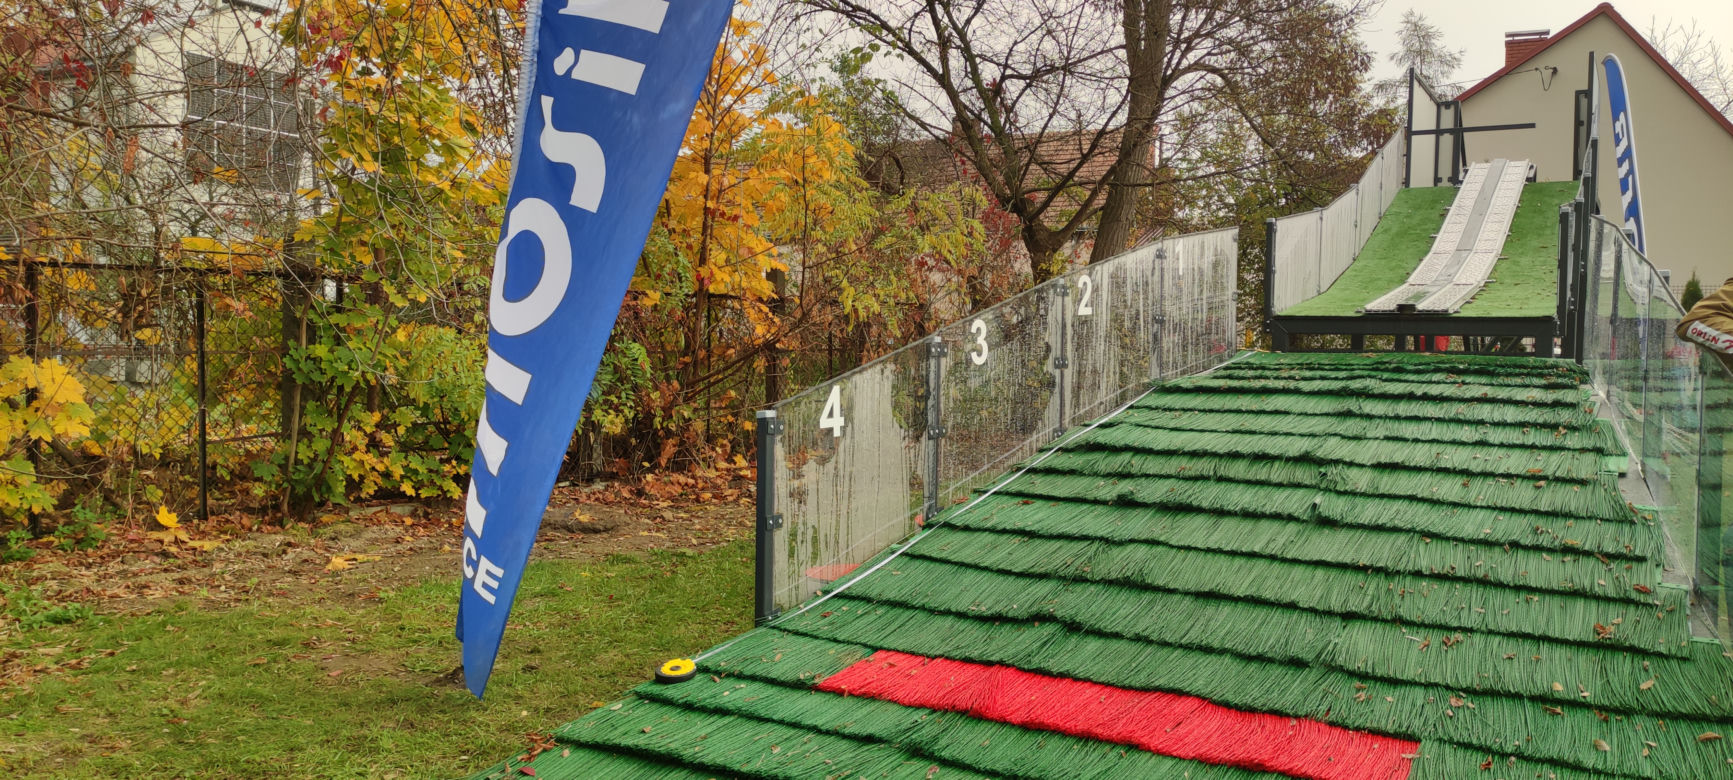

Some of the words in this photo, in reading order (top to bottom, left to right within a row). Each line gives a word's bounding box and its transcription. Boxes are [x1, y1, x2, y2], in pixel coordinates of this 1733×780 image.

[1175, 238, 1183, 275] 1
[1077, 275, 1092, 315] 2
[970, 319, 988, 365] 3
[819, 385, 845, 437] 4
